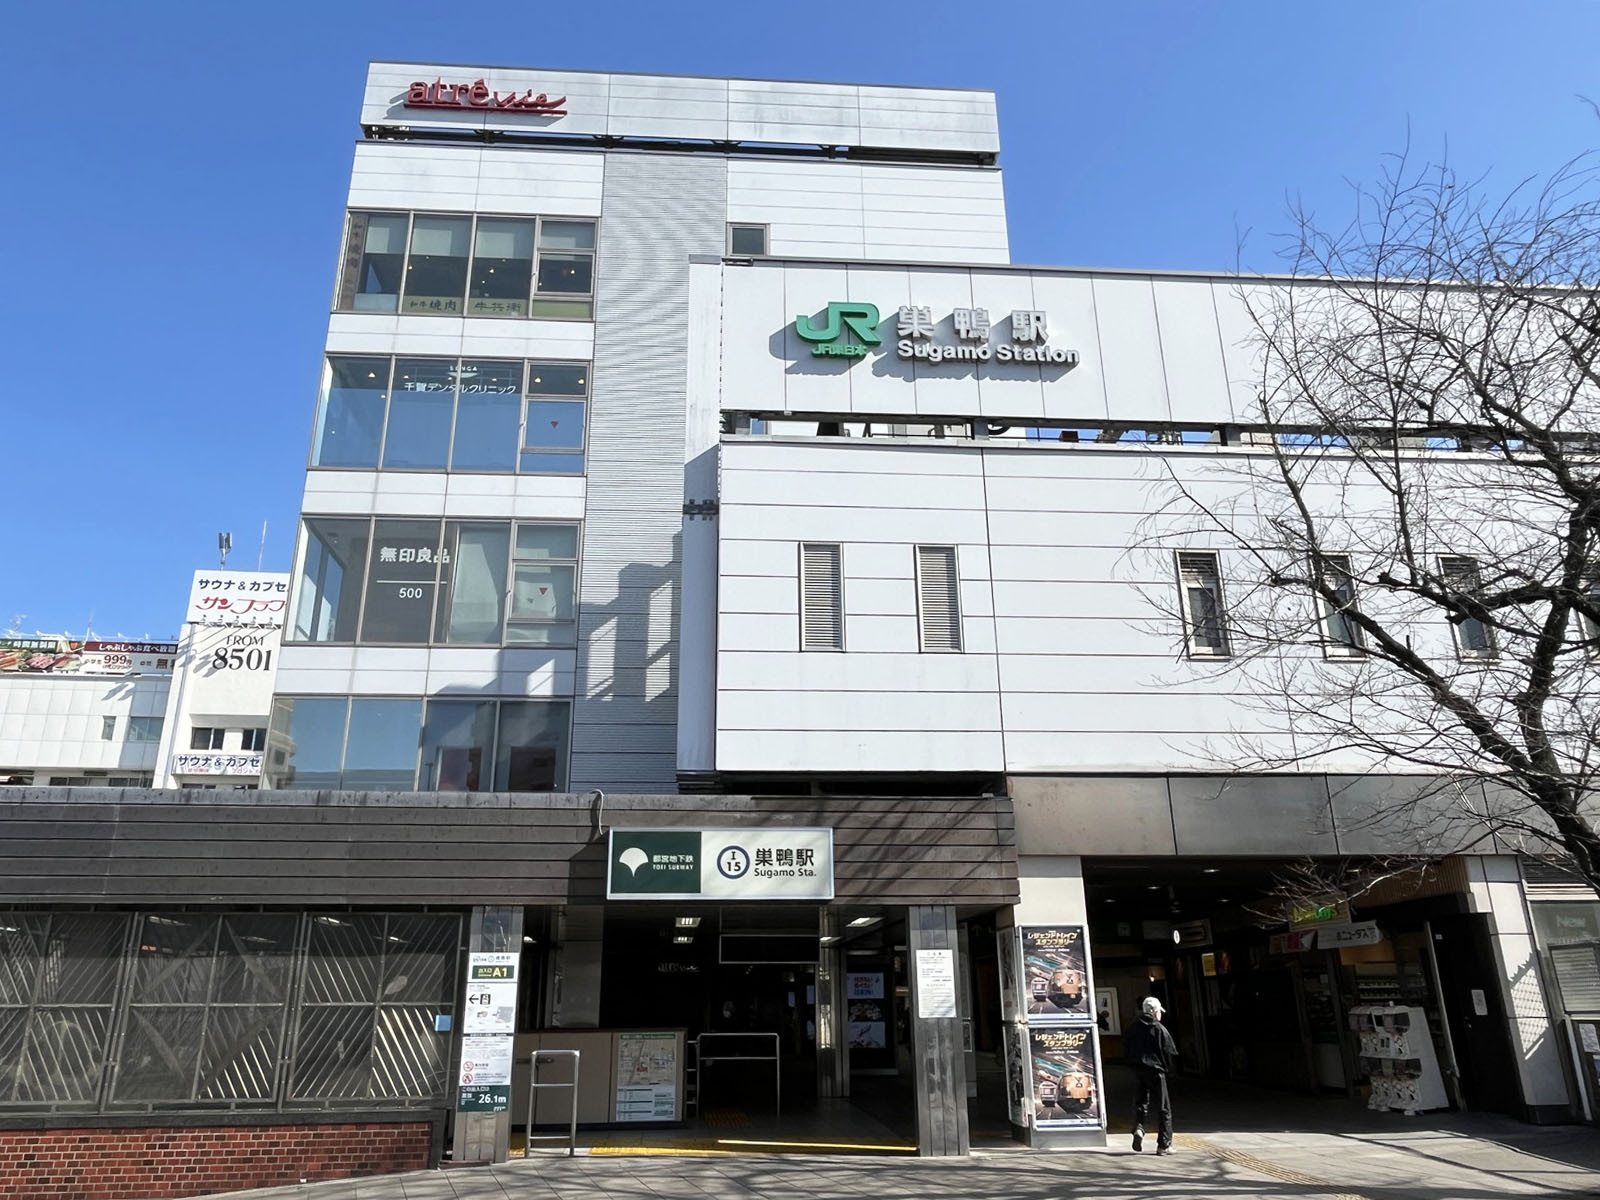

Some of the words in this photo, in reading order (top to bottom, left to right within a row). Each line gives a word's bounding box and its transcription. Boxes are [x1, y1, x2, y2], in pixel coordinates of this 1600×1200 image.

[796, 302, 881, 344] JR
[897, 306, 1050, 344] 巣鴨駅
[812, 343, 867, 358] JR東日本
[898, 340, 991, 363] Sugamo
[997, 343, 1080, 364] Station
[404, 382, 516, 395] 千賀デンタルクリニック
[380, 547, 450, 563] 無印良品
[399, 587, 423, 599] 500
[226, 635, 264, 646] FROM
[99, 643, 176, 654] しゃぶしゃぶ食べ放題
[212, 647, 272, 671] 8501
[653, 854, 694, 863] 都営地下鉄
[730, 851, 736, 860] I
[754, 847, 814, 867] 巣鴨駅
[726, 861, 741, 872] 15
[754, 867, 795, 879] Sugamo
[798, 867, 817, 877] Sta.
[493, 967, 507, 977] A1
[478, 1093, 506, 1104] 26.1m
